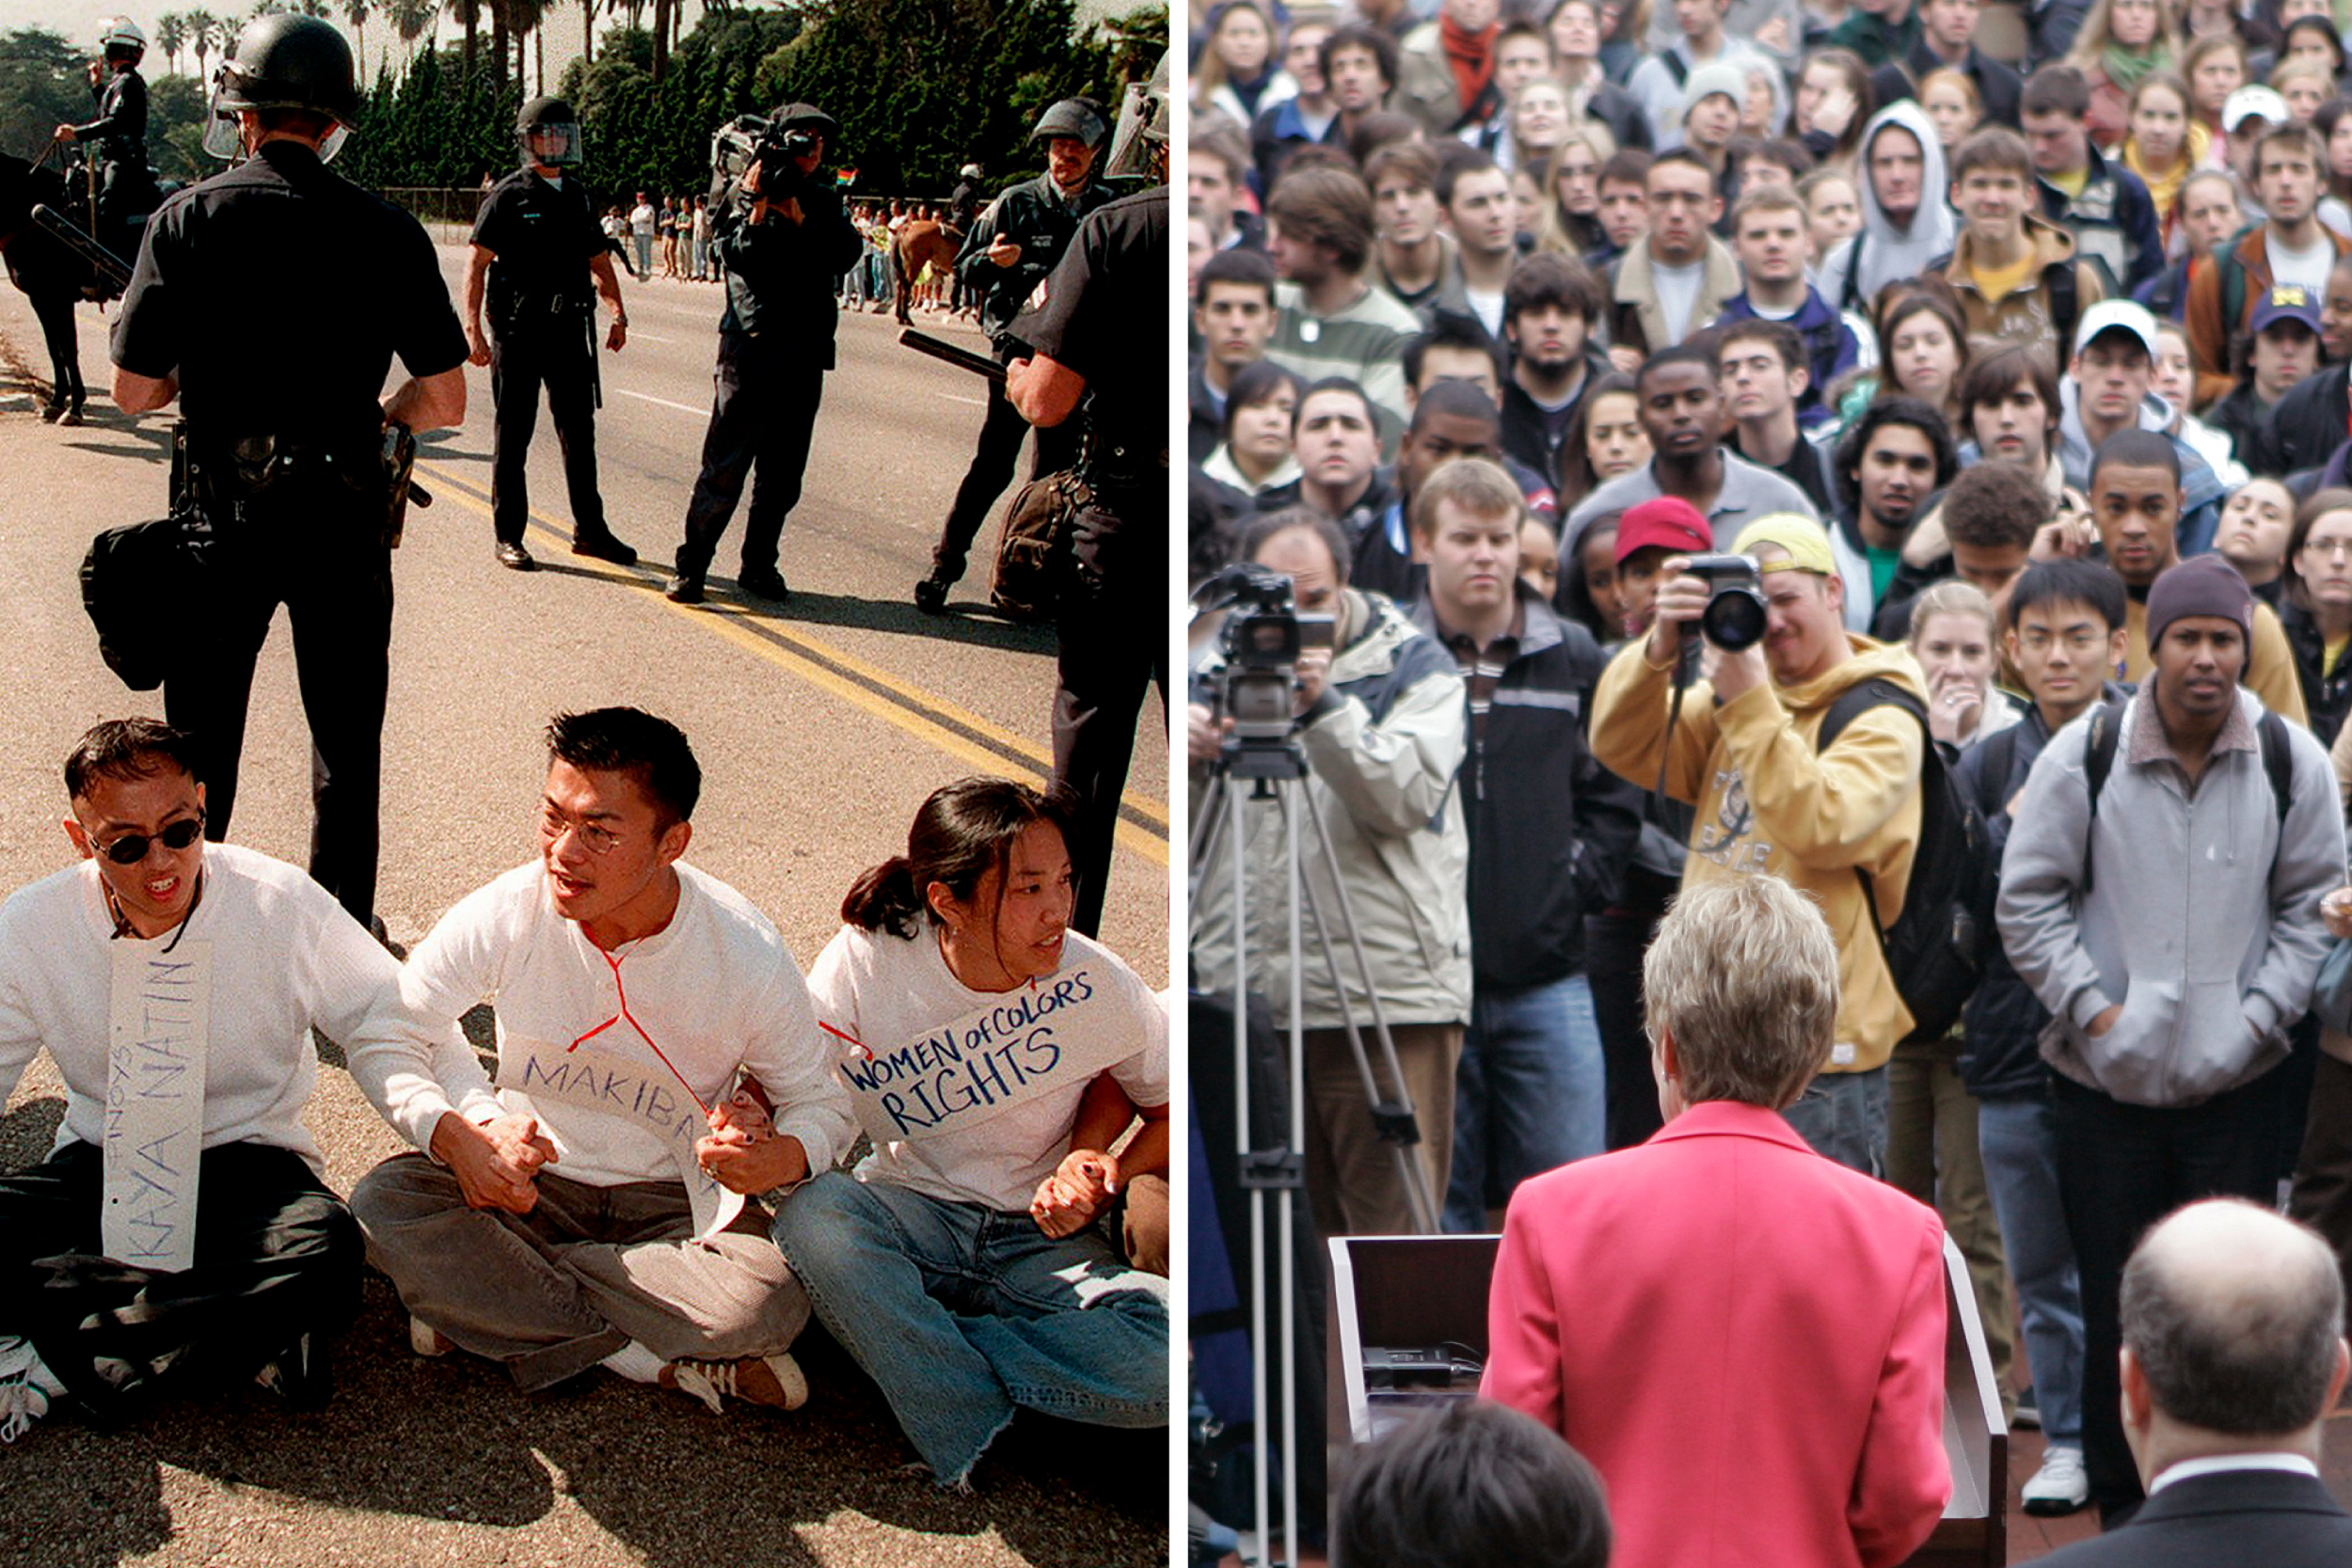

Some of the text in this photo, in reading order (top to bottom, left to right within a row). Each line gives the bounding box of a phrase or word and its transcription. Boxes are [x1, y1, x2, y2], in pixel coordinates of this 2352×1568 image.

[840, 1029, 962, 1091] WOMEN
[993, 972, 1092, 1036] COLORS
[881, 1027, 1061, 1136] RIGHTS
[128, 961, 193, 1257] KAYA NATIN
